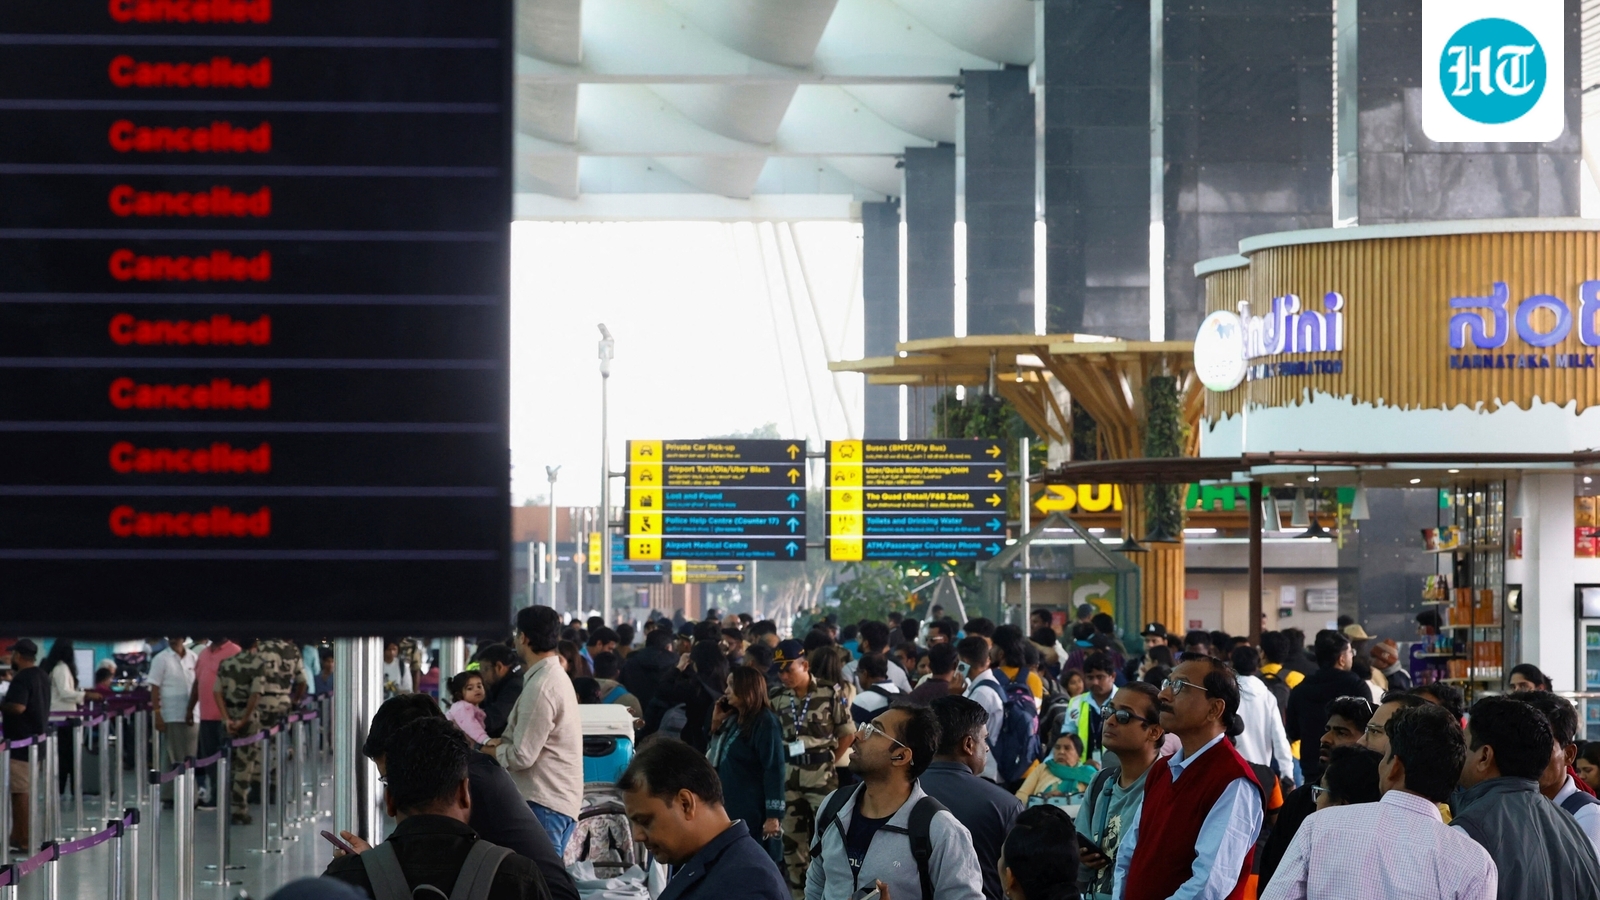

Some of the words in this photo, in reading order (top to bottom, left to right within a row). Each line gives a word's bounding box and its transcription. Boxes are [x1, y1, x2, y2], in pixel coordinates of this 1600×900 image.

[110, 0, 271, 22] Cancelled
[109, 56, 271, 86] Cancelled
[109, 121, 271, 151] Cancelled
[109, 186, 271, 215] Cancelled
[109, 250, 271, 280] Cancelled
[109, 315, 271, 344] Cancelled
[1450, 353, 1550, 369] KARNATAKA
[1555, 353, 1595, 369] MILK
[109, 379, 271, 408] Cancelled
[666, 443, 691, 452] Private
[693, 443, 706, 452] Car
[707, 443, 736, 452] Pick-up
[866, 444, 887, 452] Buses
[889, 444, 927, 452] (BMTC/Fly
[929, 444, 947, 452] Bus)
[109, 443, 271, 472] Cancelled
[668, 465, 695, 474] Airport
[750, 465, 770, 474] Black
[866, 466, 904, 475] Uber/Quick
[666, 492, 682, 501] Lost
[683, 492, 698, 501] and
[699, 492, 723, 501] Found
[866, 492, 880, 501] The
[882, 492, 902, 501] Quad
[947, 492, 969, 501] Zone)
[109, 507, 271, 536] Cancelled
[665, 516, 688, 525] Police
[689, 516, 707, 525] Help
[708, 516, 733, 525] Centre
[734, 516, 767, 525] (Counter
[768, 516, 780, 525] 17)
[866, 516, 891, 526] Toilets
[892, 516, 906, 526] and
[908, 516, 938, 526] Drinking
[940, 516, 963, 526] Water
[665, 541, 692, 550] Airport
[693, 541, 722, 550] Medical
[724, 541, 748, 550] Centre
[866, 541, 923, 551] ATM/Passenger
[924, 541, 957, 551] Courtesy
[958, 541, 982, 551] Phone
